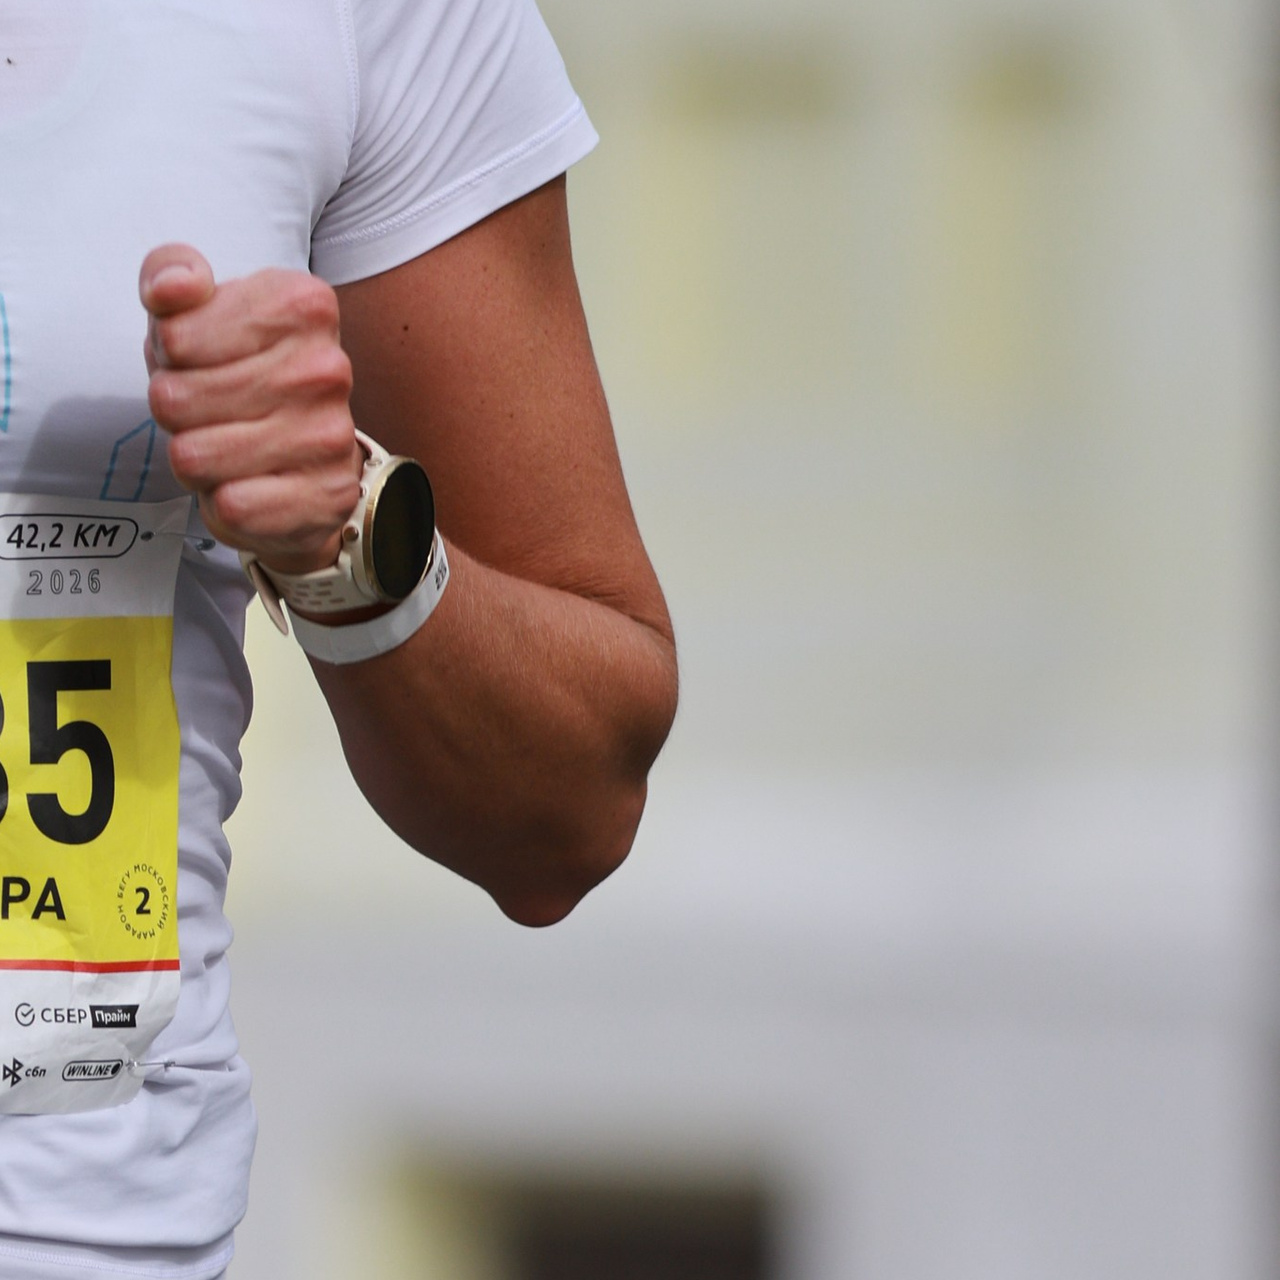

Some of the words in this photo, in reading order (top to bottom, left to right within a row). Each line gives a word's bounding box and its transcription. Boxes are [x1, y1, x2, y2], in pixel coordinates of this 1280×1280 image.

[6, 524, 63, 552] 42,2
[72, 523, 121, 548] КМ
[26, 569, 102, 595] 2026
[135, 886, 151, 915] 2
[40, 1007, 87, 1024] СБЕР
[94, 1009, 131, 1024] Прайм
[24, 1065, 47, 1078] сбп
[66, 1063, 112, 1078] WINLINE
